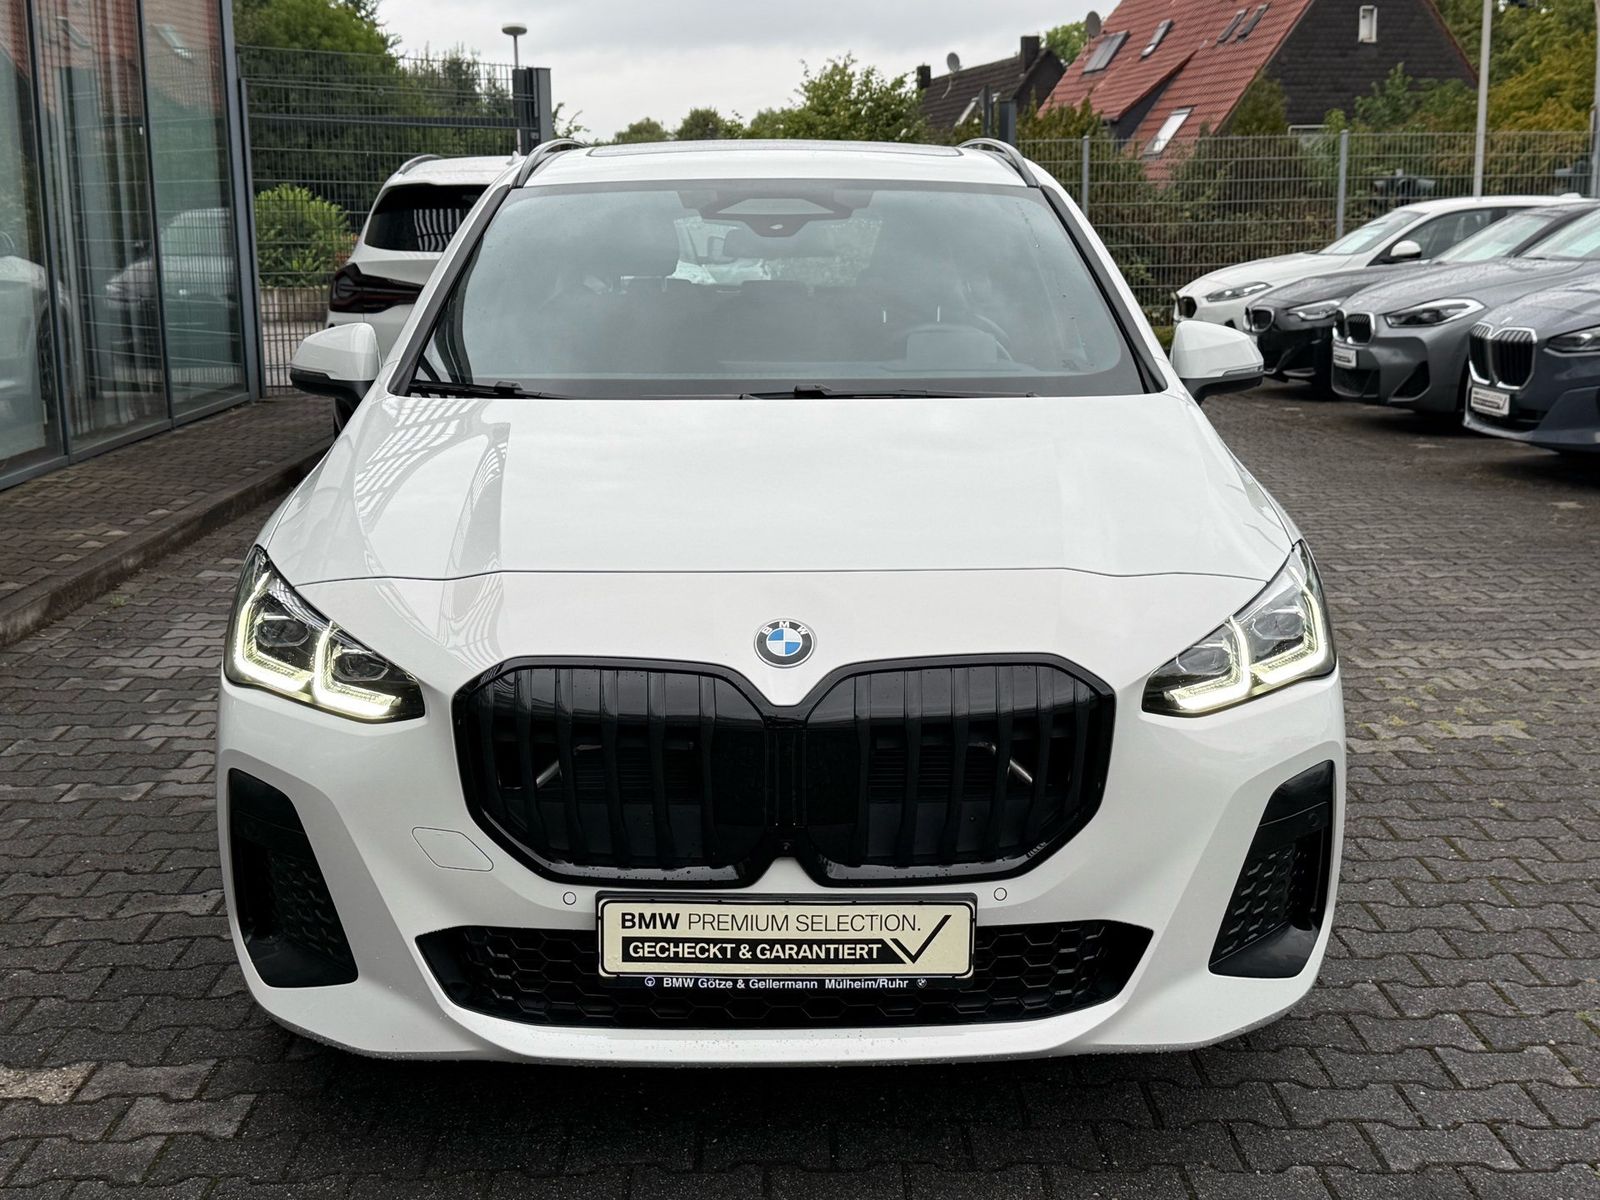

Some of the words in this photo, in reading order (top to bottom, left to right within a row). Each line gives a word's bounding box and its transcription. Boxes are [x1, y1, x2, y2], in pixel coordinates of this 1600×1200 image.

[761, 620, 809, 635] BMW
[621, 912, 680, 930] BMW
[688, 913, 789, 931] PREMIUM
[795, 913, 921, 932] SELECTION.
[629, 942, 736, 958] GECHECKT
[738, 943, 752, 959] &
[756, 943, 882, 959] GARANTIERT
[663, 977, 695, 988] BMW
[698, 978, 733, 989] Götze
[736, 979, 746, 989] &
[749, 978, 818, 989] Gellermann
[825, 978, 909, 989] Mülheim/Ruhr
